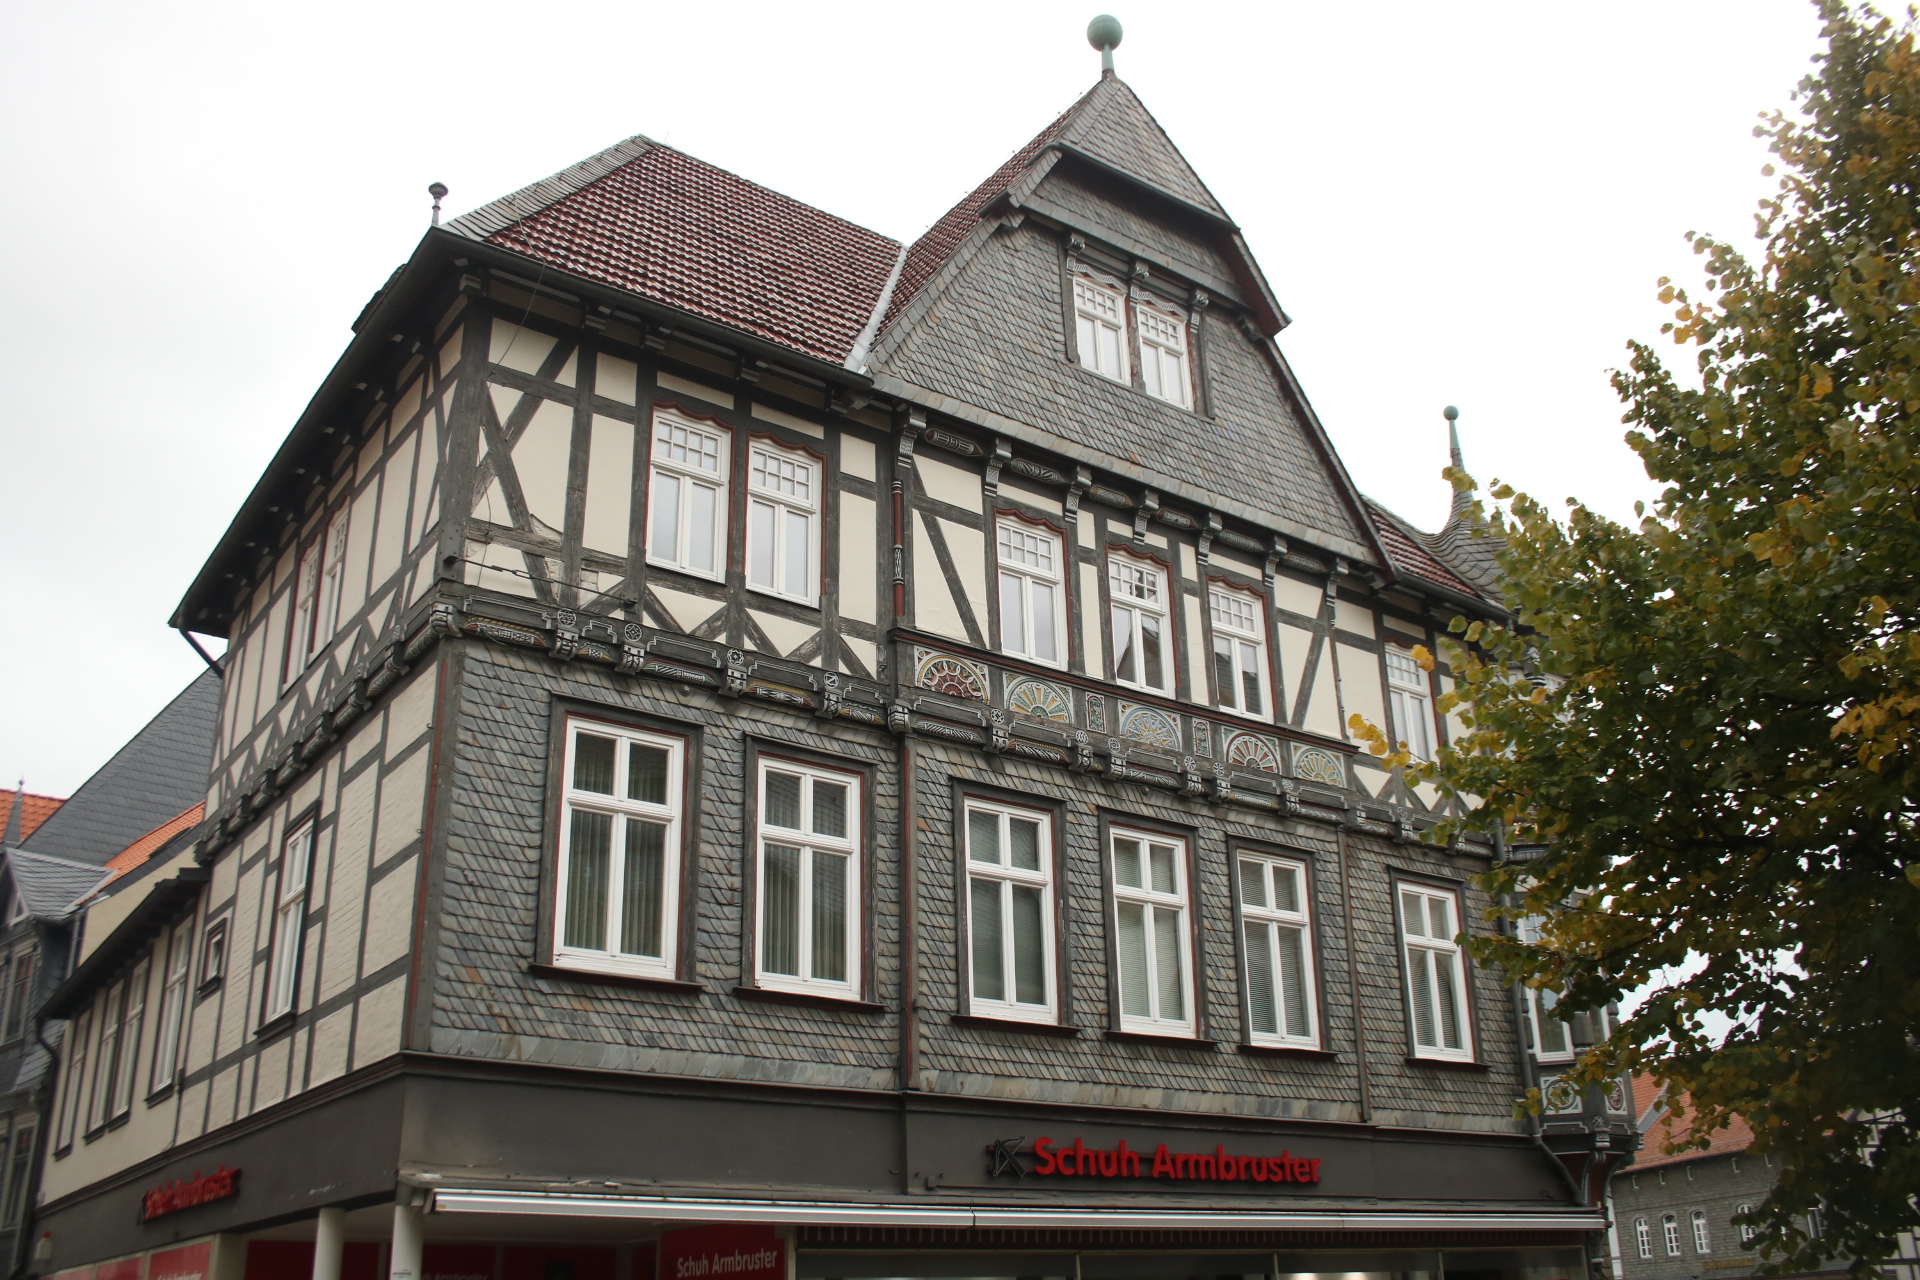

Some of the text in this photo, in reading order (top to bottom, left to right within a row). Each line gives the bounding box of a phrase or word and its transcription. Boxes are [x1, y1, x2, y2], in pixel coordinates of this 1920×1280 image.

[1033, 1137, 1322, 1183] Schuh Armbruster
[676, 1247, 778, 1278] Schuh Armbruster
